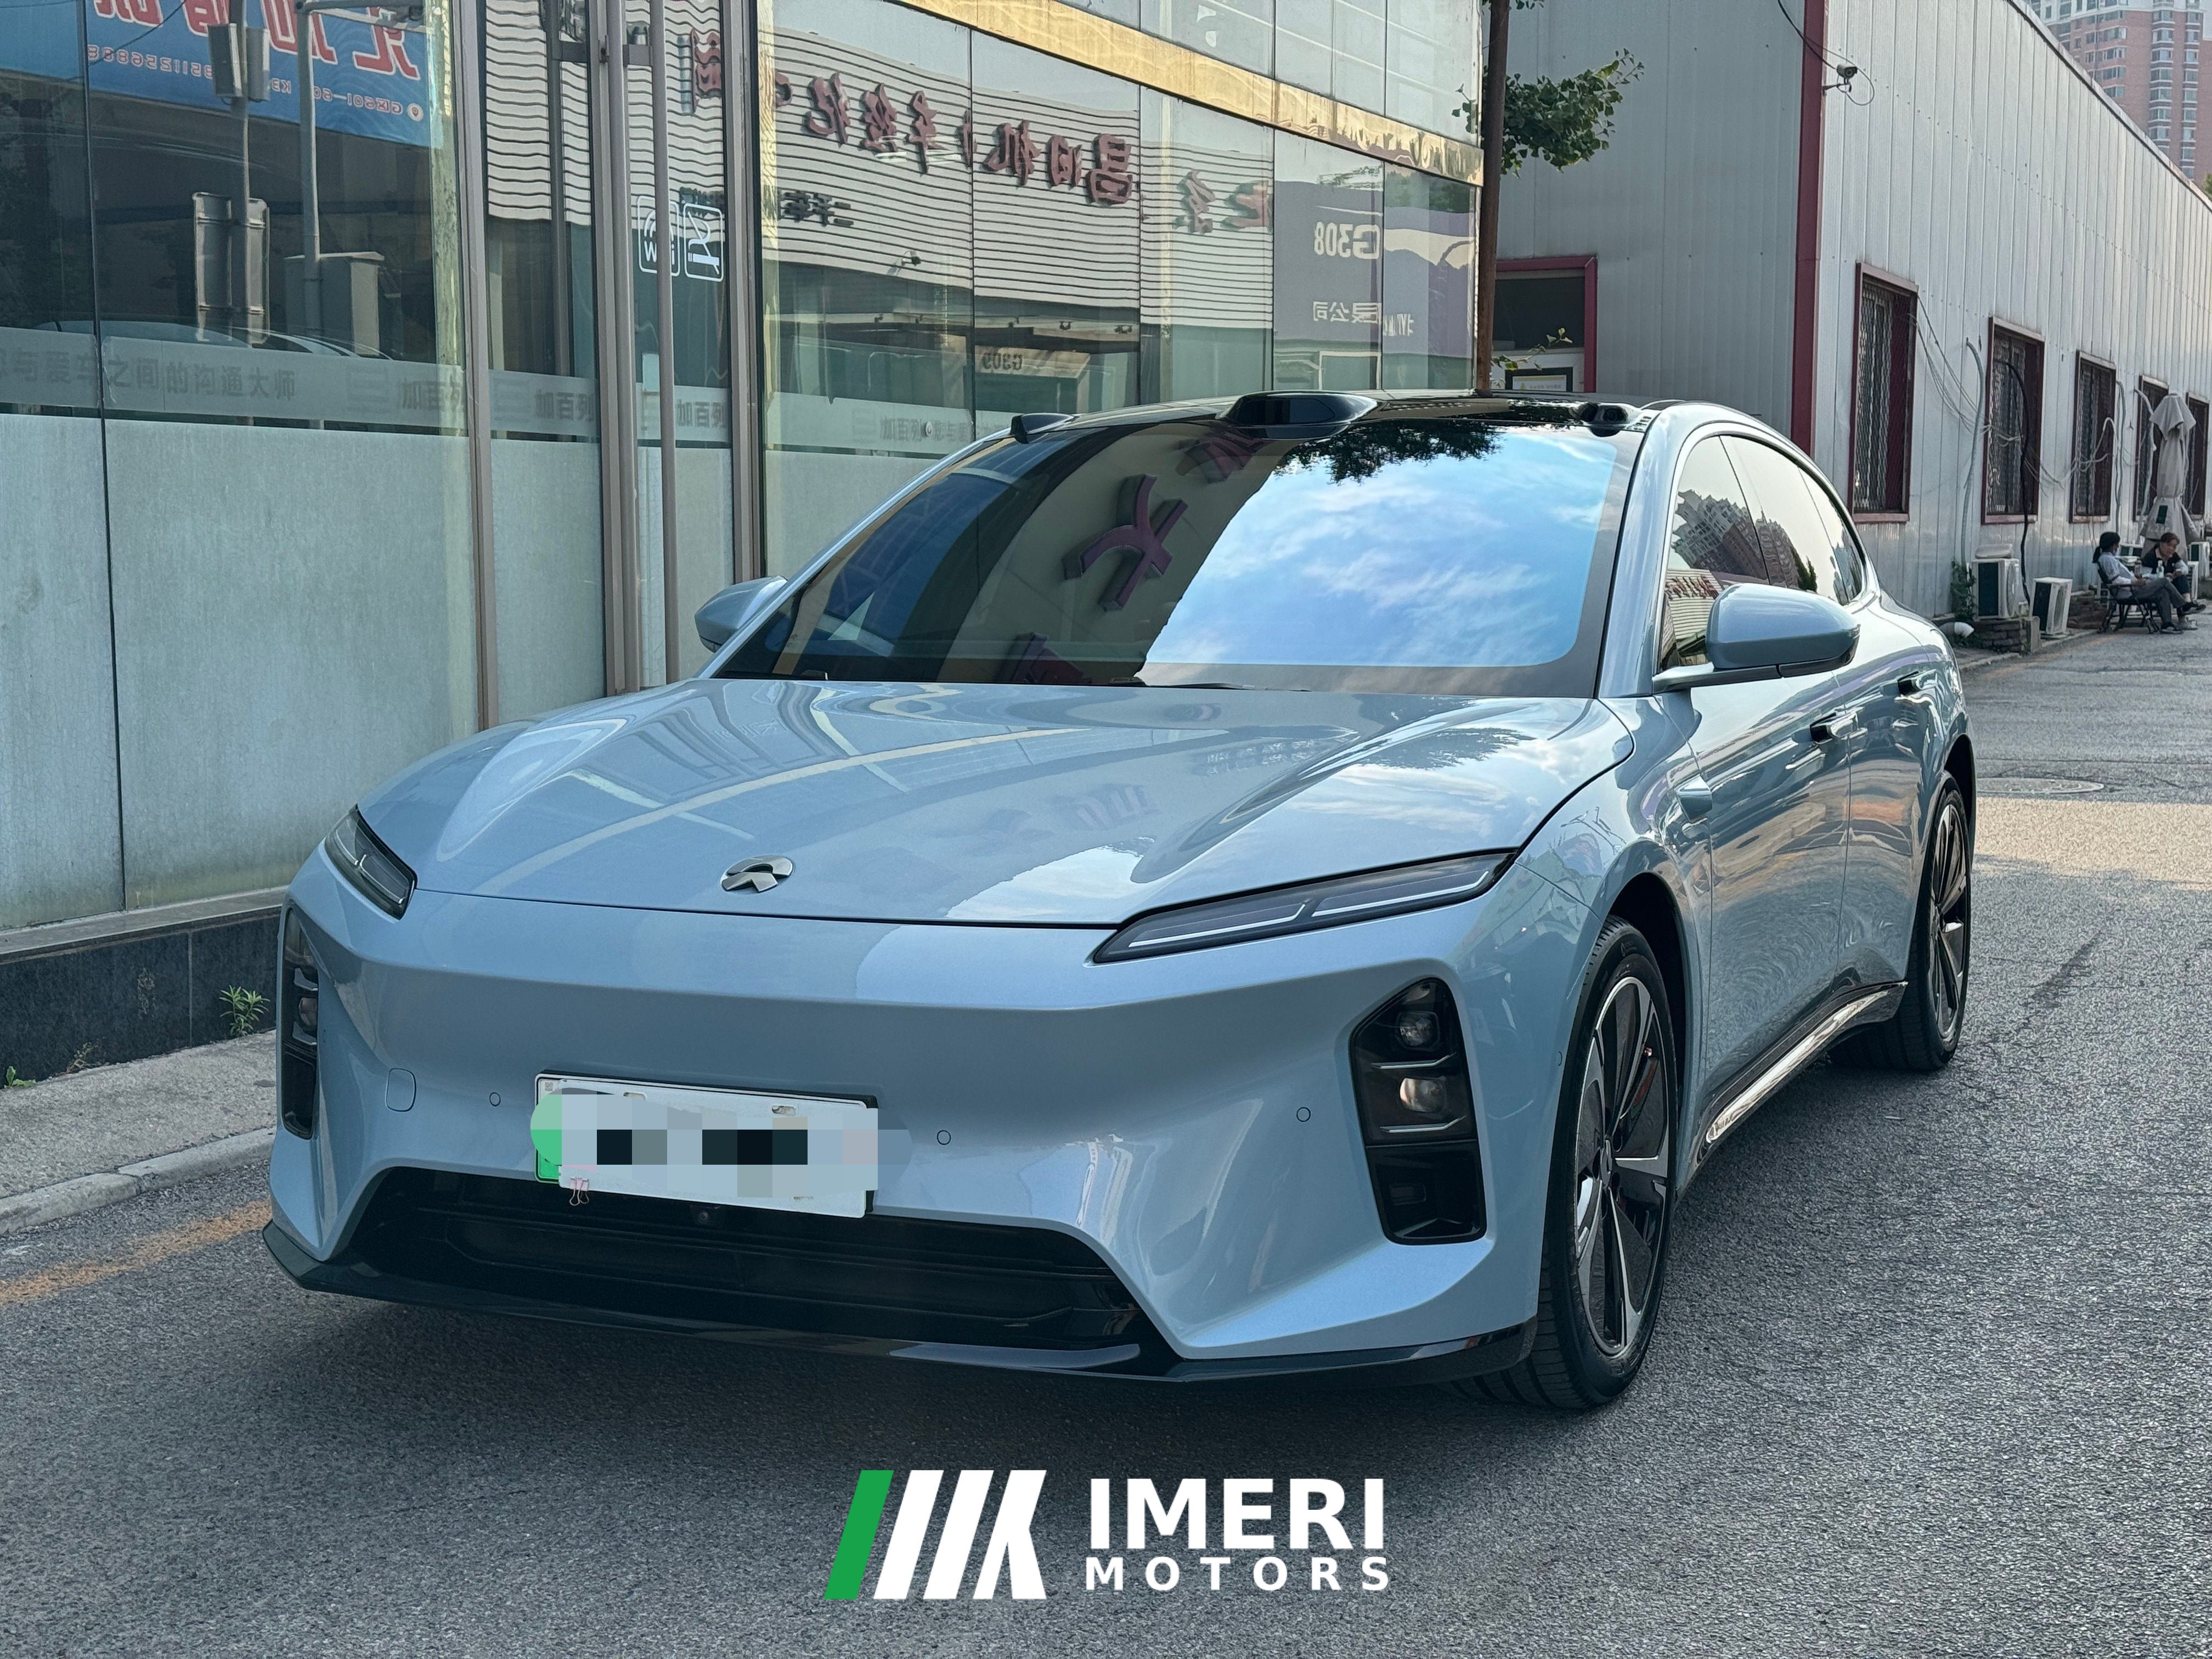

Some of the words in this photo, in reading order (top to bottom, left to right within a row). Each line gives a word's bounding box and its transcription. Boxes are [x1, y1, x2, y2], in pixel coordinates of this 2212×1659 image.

[0, 348, 295, 402] 与爱车之间的沟通大师
